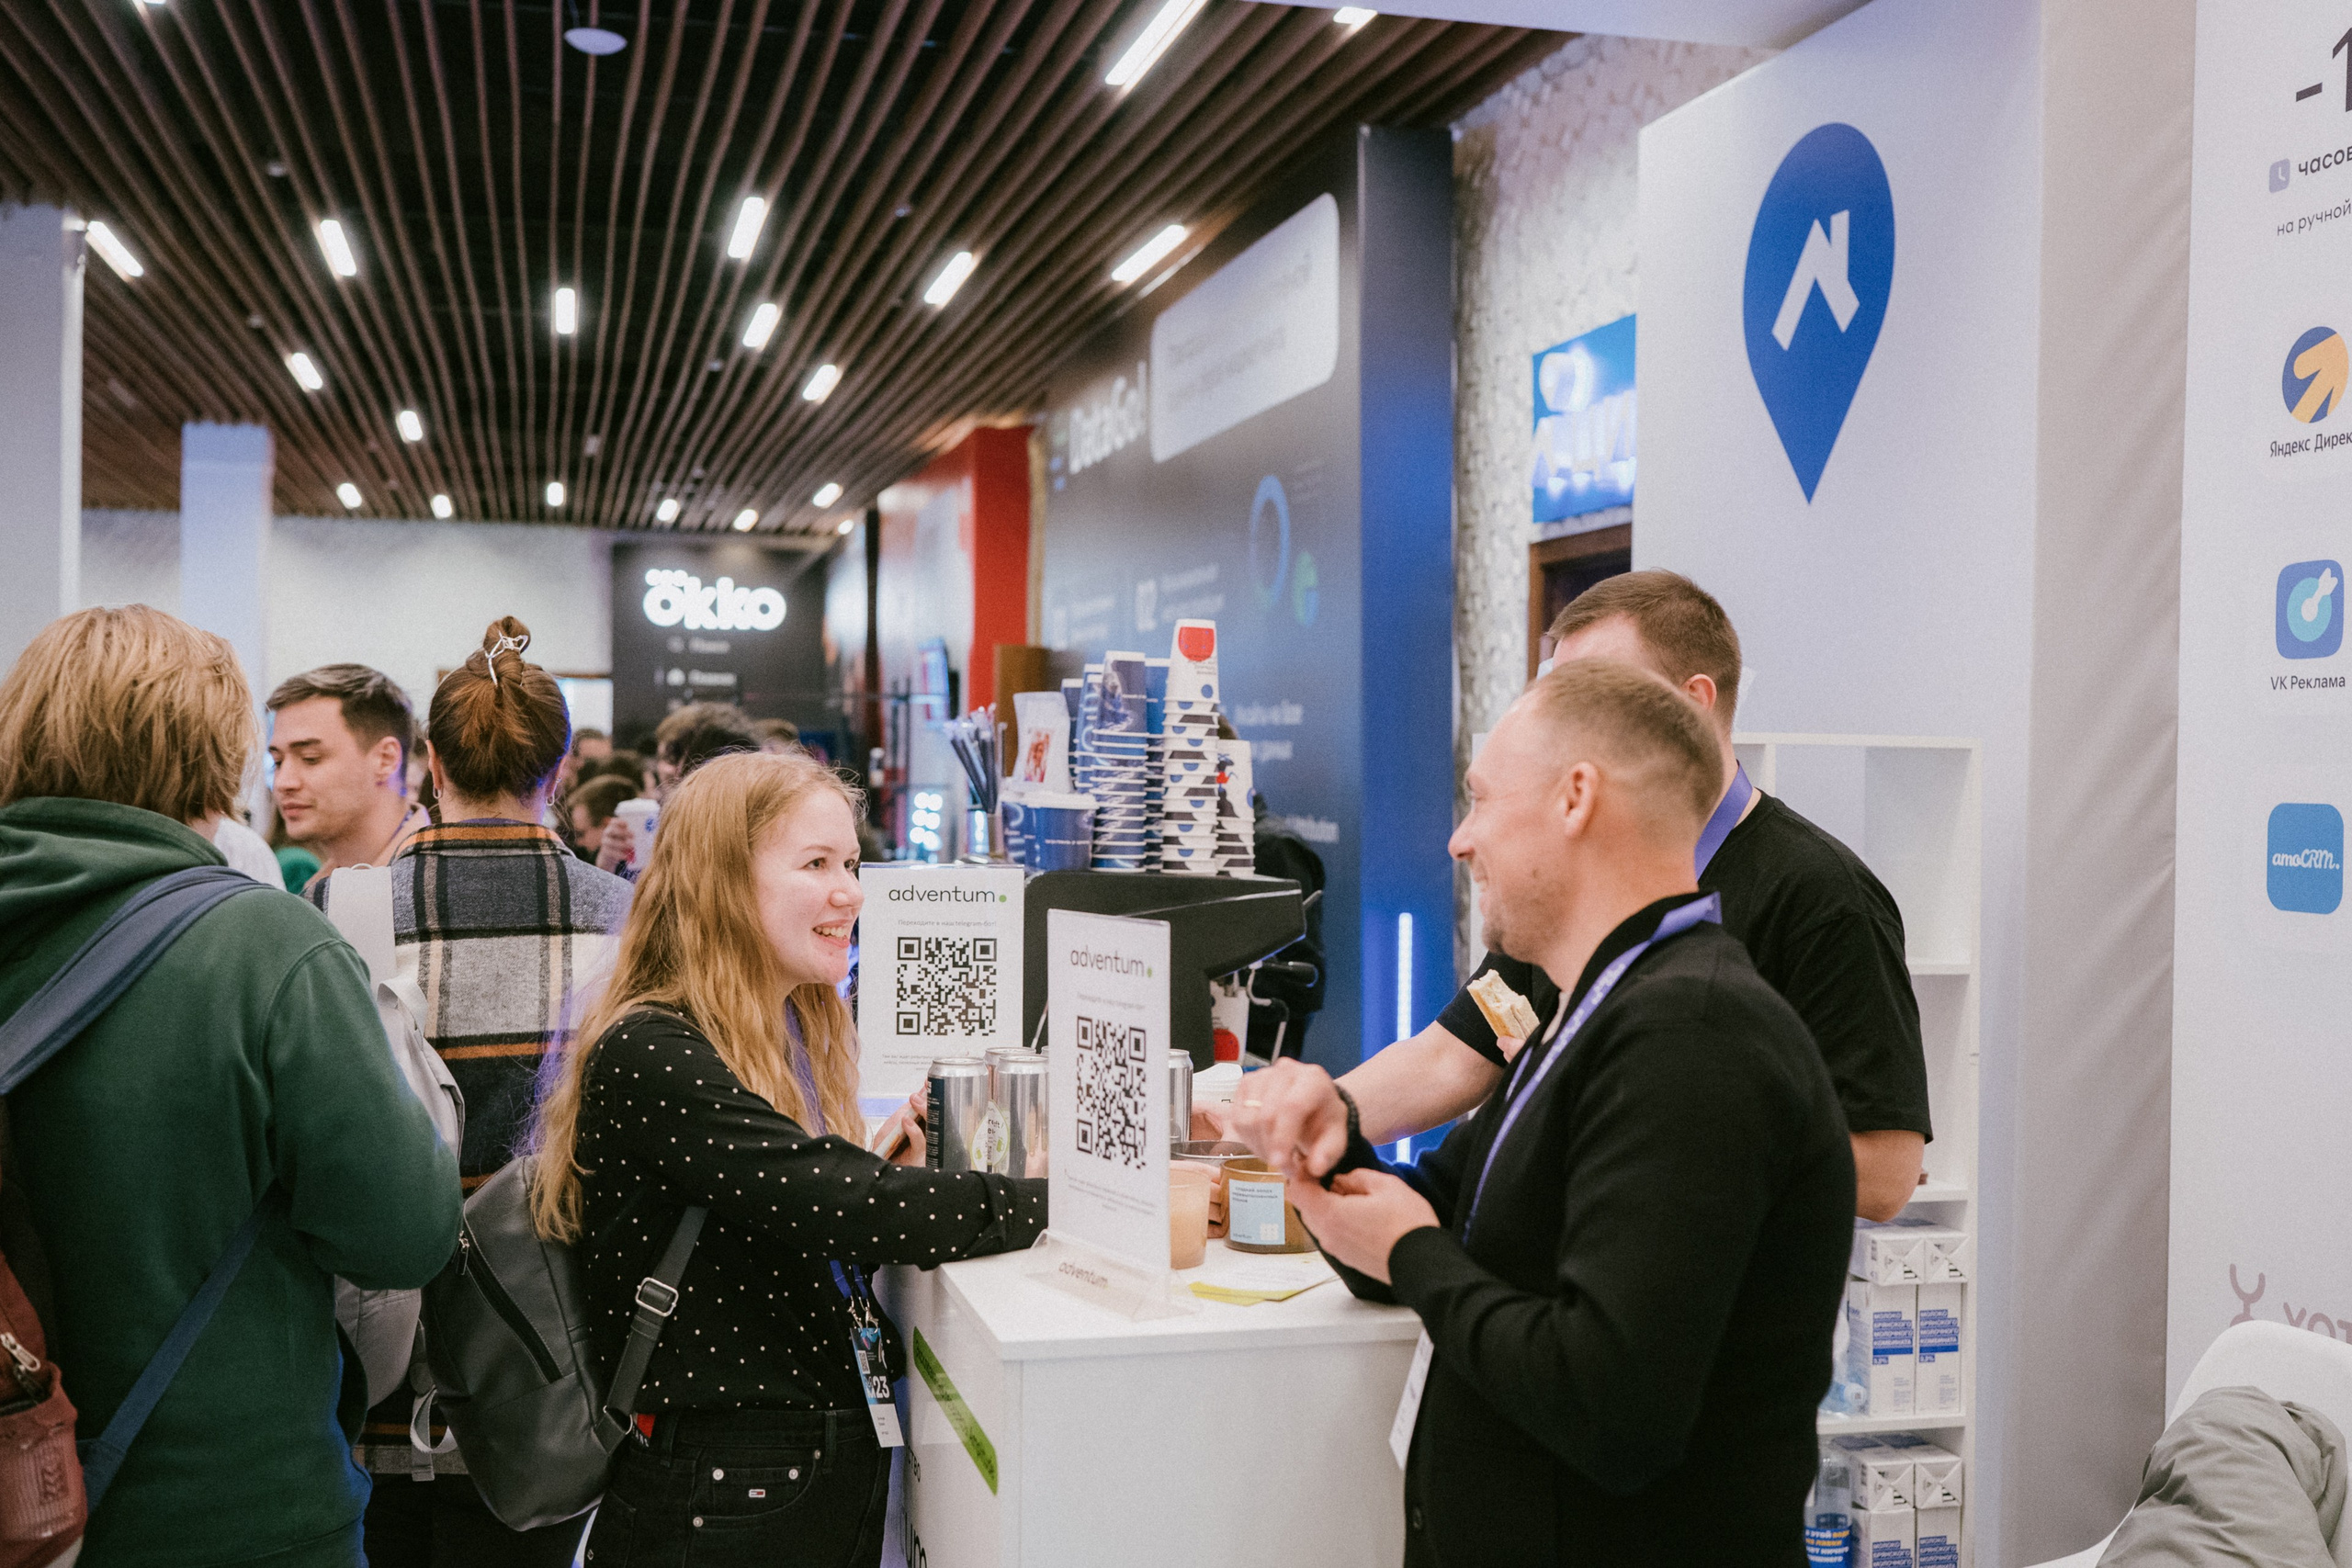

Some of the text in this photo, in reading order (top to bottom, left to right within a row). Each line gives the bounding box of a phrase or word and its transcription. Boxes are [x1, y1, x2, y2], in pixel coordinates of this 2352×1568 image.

[2277, 198, 2352, 236] на ручной
[2270, 438, 2311, 457] Яндекс
[2270, 675, 2346, 690] VK Реклама
